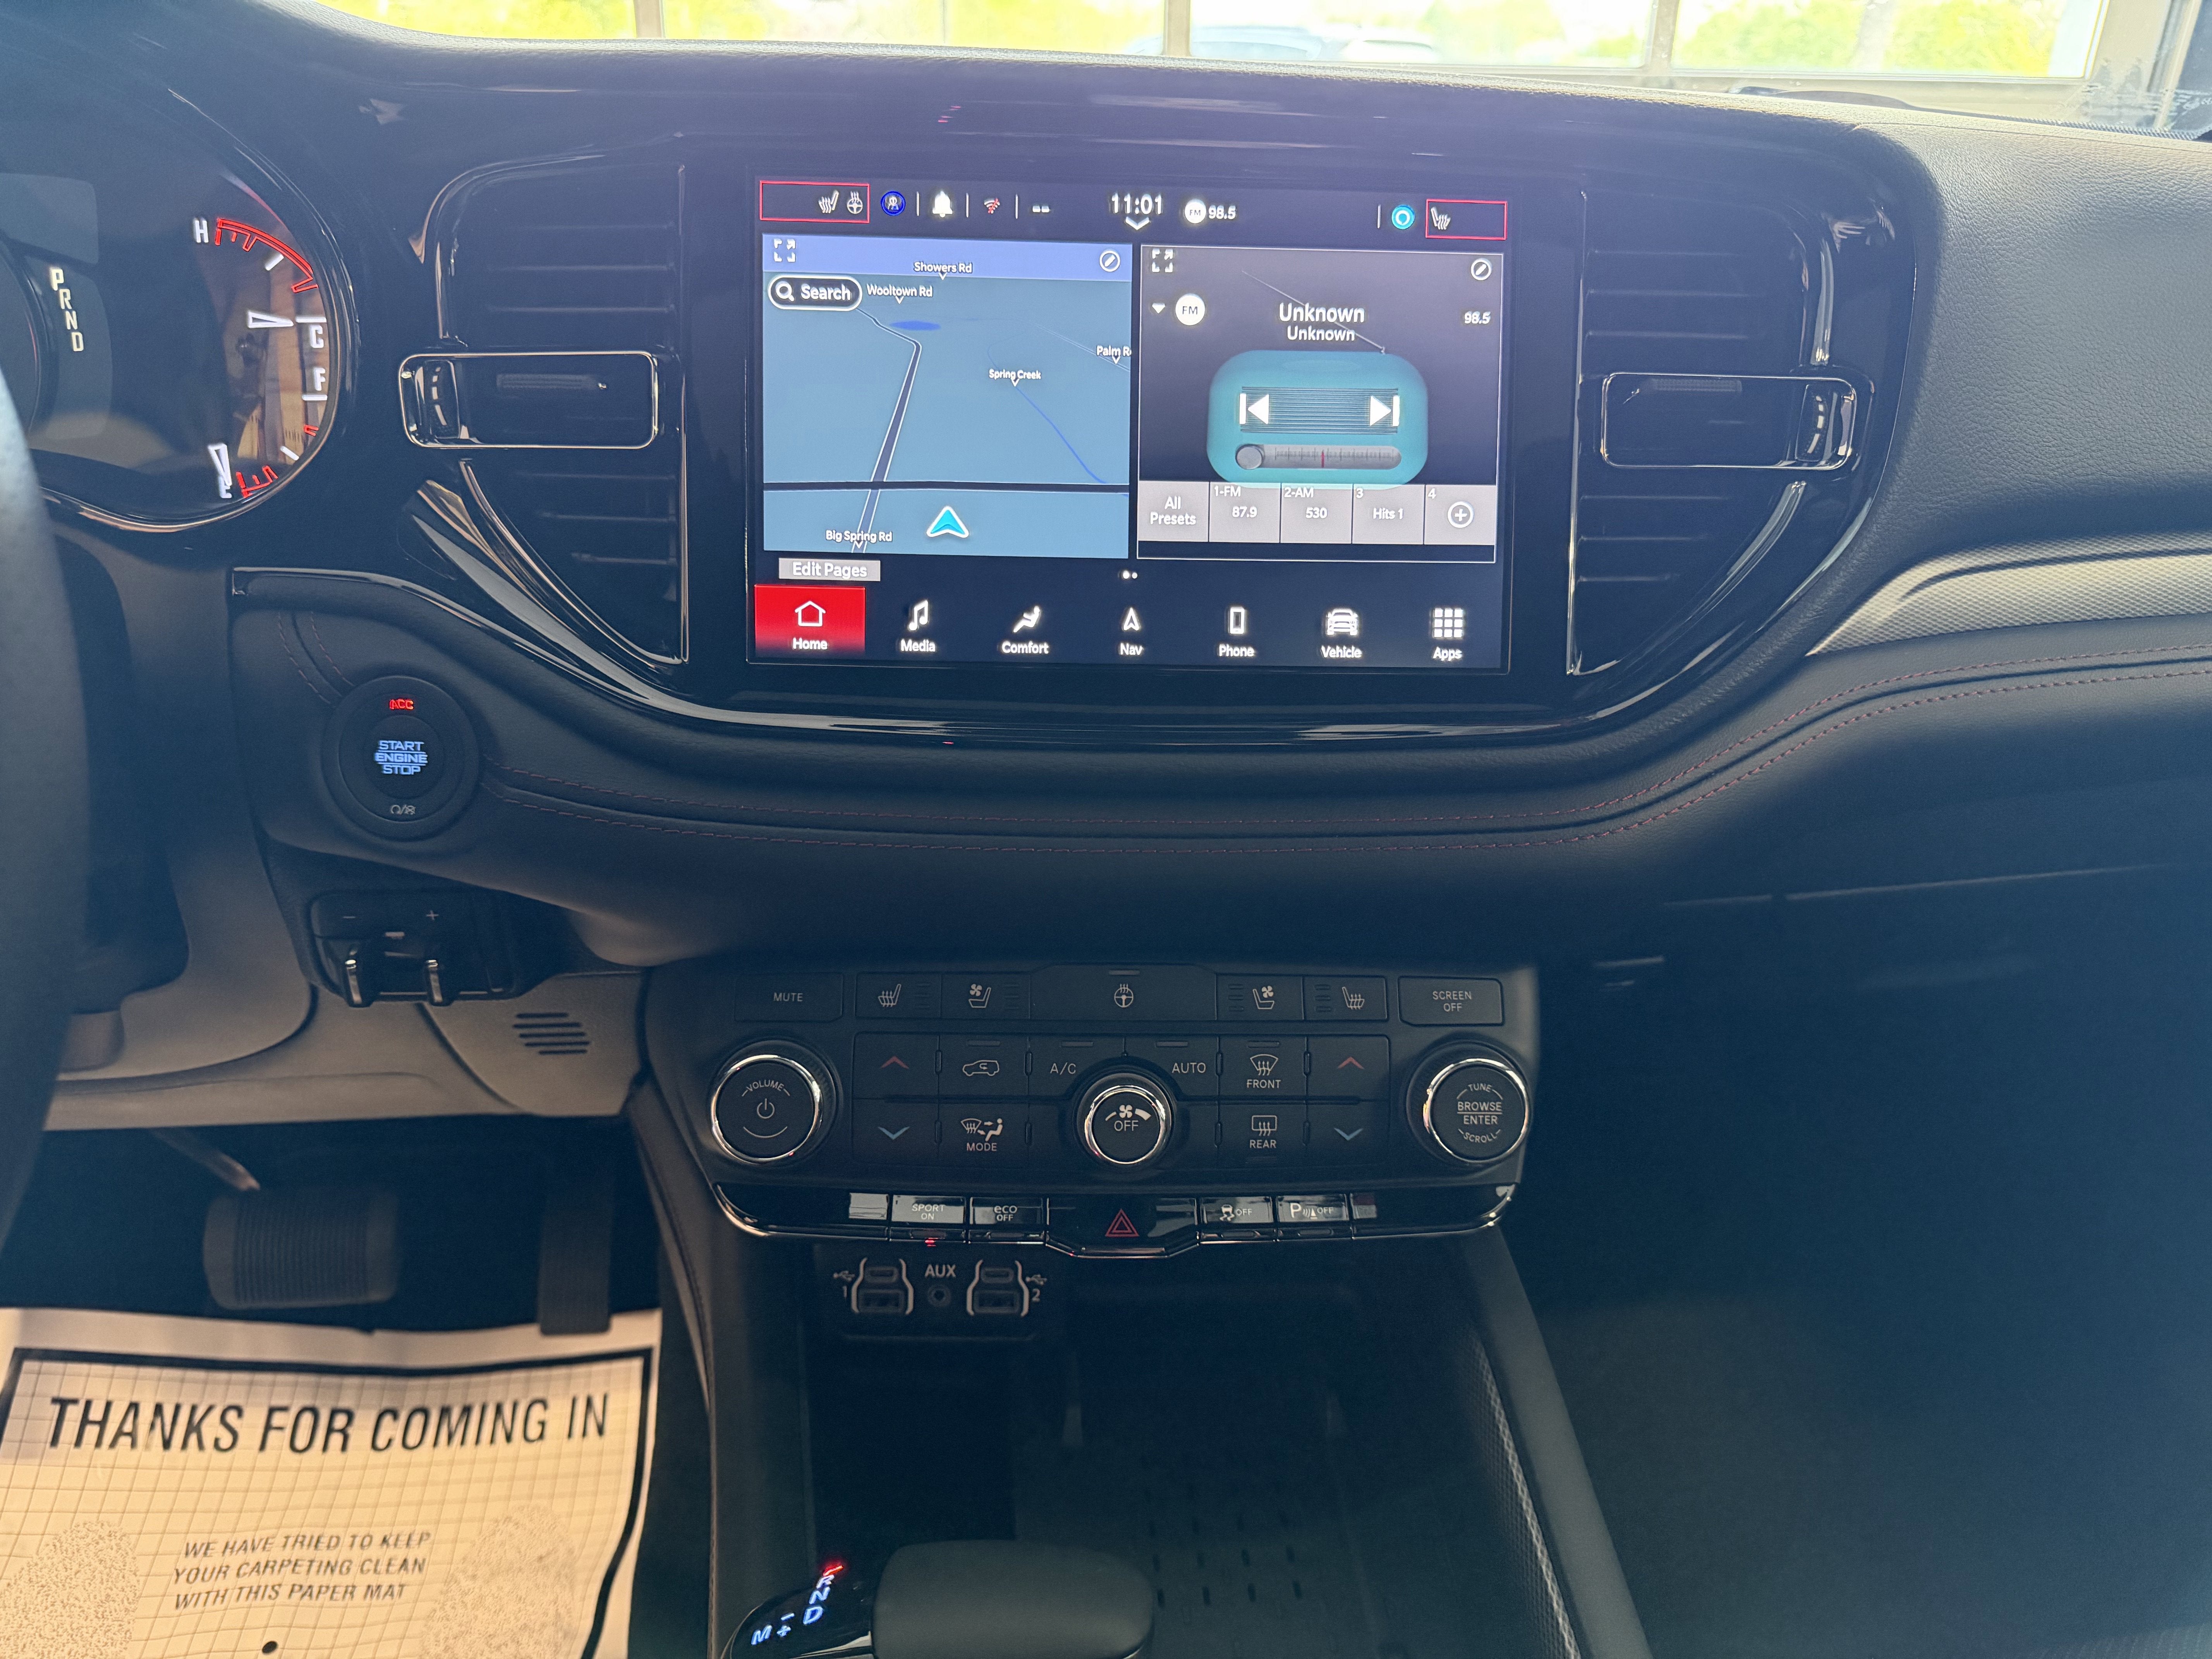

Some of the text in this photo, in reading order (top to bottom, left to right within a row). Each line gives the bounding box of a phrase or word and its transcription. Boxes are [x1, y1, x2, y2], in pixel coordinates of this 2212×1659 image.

[1110, 192, 1163, 216] 11:01
[1189, 204, 1237, 220] FM 98.5
[194, 218, 208, 243] H
[914, 261, 972, 273] Showers Rd
[800, 284, 851, 301] Search
[867, 285, 933, 297] Wooltown Rd
[1182, 305, 1198, 315] FM
[1279, 302, 1365, 323] Unknown
[1464, 311, 1491, 325] 98.5
[310, 325, 324, 348] C
[1286, 325, 1355, 342] Unknown
[1096, 345, 1121, 356] Palm
[314, 368, 326, 391] F
[989, 369, 1041, 380] Spring Creek
[1213, 486, 1241, 498] 1-FM
[1284, 487, 1314, 499] 2-AM
[1356, 488, 1364, 499] 3
[1427, 489, 1436, 500] 4
[1164, 496, 1182, 511] All
[1232, 506, 1257, 519] 87.9
[1305, 507, 1328, 519] 530
[1373, 507, 1395, 520] Hits
[1150, 511, 1197, 527] Presets
[826, 530, 892, 544] Big Spring Rd
[792, 562, 867, 579] Edit Pages
[793, 638, 828, 651] Home
[900, 640, 936, 653] Media
[1002, 641, 1049, 654] Comfort
[1120, 644, 1143, 656] Nav
[1219, 645, 1255, 658] Phone
[1321, 646, 1362, 659] Vehicle
[1433, 647, 1463, 661] Apps
[389, 699, 414, 709] ACC
[379, 740, 424, 751] START
[375, 753, 428, 763] ENGINE
[382, 765, 421, 775] STOP
[774, 993, 803, 1002] MUTE
[1432, 991, 1472, 1000] SCREEN
[1443, 1002, 1462, 1012] OFF
[1050, 1062, 1076, 1075] A/C
[1172, 1063, 1206, 1073] AUTO
[746, 1080, 784, 1092] VOLUME
[1246, 1079, 1281, 1089] FRONT
[1468, 1083, 1493, 1092] TUNE
[1457, 1102, 1502, 1111] BROWSE
[1463, 1115, 1498, 1125] ENTER
[1114, 1121, 1138, 1132] OFF
[1463, 1131, 1498, 1143] SCROLL
[967, 1143, 997, 1151] MODE
[1249, 1140, 1276, 1149] REAR
[912, 1204, 944, 1212] SPORT
[994, 1205, 1017, 1214] eco
[925, 1264, 957, 1278] AUX
[1032, 1289, 1040, 1302] 2
[49, 1393, 609, 1454] THANKS FOR COMING IN
[184, 1532, 431, 1558] WE HAVE TRIED TO KEEP
[174, 1558, 426, 1585] YOUR CARPETING CLEAN
[175, 1584, 407, 1609] WITH THIS PAPER MAT
